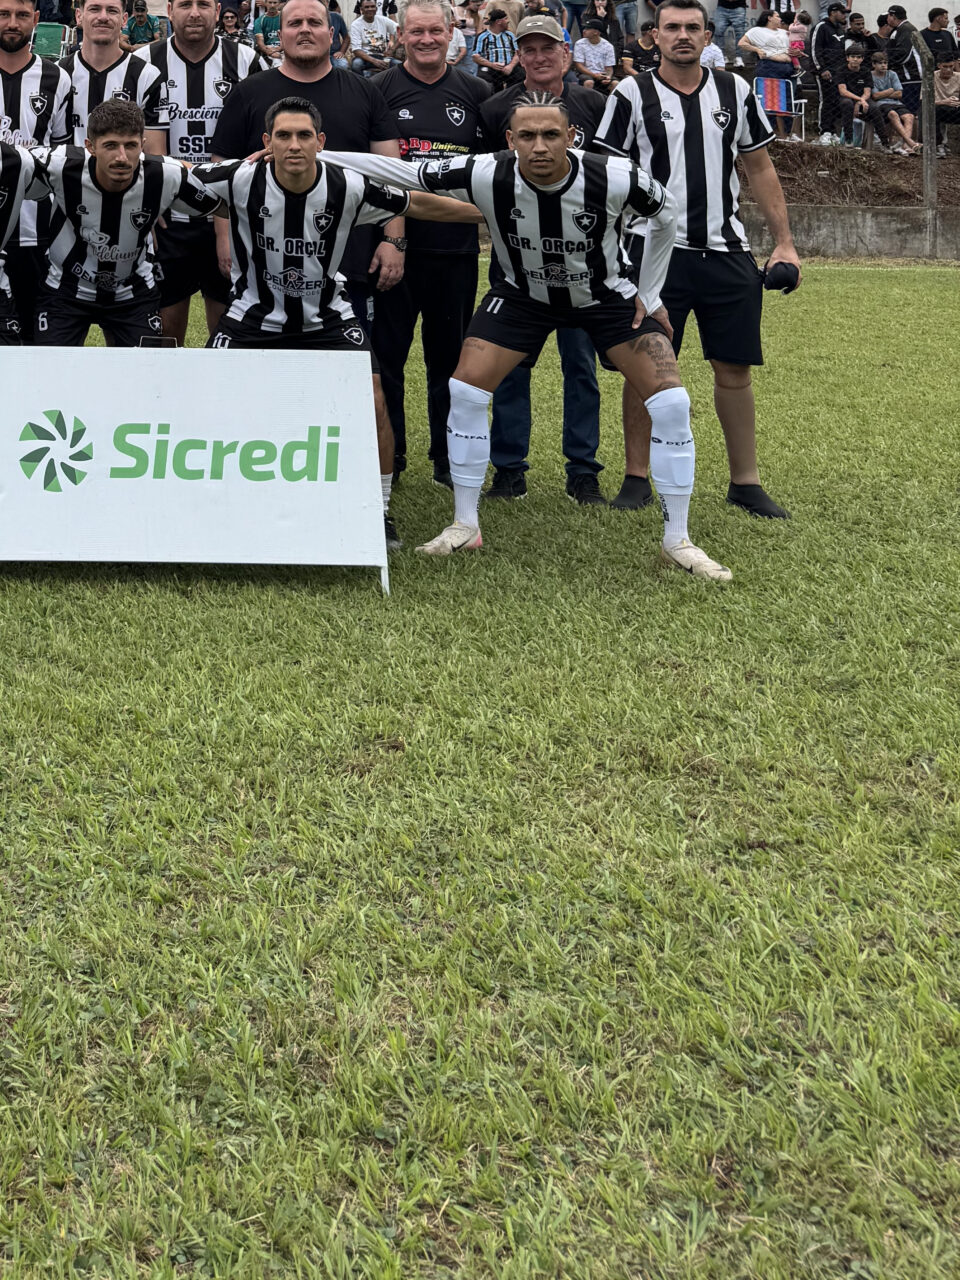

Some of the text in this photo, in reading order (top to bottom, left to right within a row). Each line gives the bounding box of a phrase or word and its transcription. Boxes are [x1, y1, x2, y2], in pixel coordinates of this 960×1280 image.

[71, 113, 84, 128] R.
[168, 102, 222, 122] Brescien
[409, 138, 432, 151] RD
[256, 232, 280, 252] DR.
[508, 233, 595, 256] DR. ORÇAL
[264, 270, 326, 290] DELAZERI
[486, 296, 505, 315] 11
[38, 311, 49, 331] 6
[109, 422, 341, 482] Sicredi
